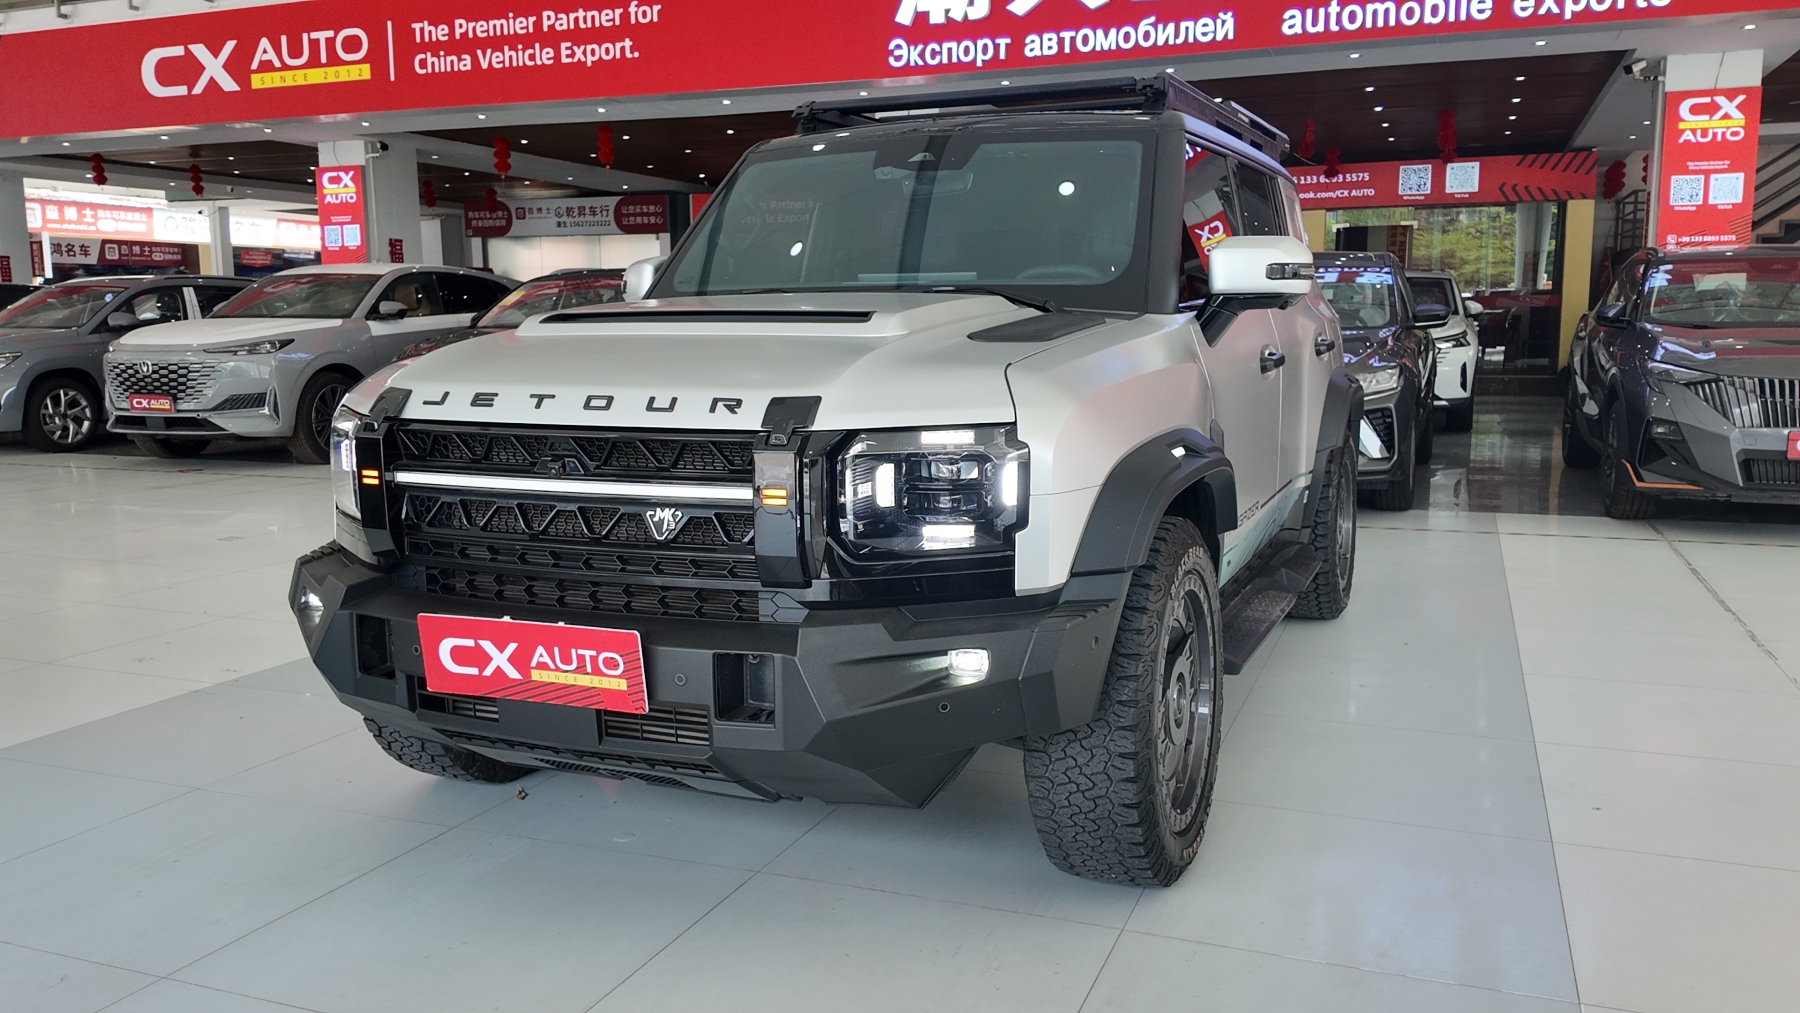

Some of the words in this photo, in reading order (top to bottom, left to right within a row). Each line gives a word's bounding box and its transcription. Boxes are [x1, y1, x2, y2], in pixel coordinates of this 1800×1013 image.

[411, 20, 449, 43] The
[454, 12, 537, 40] Premier
[542, 7, 624, 32] Partner
[628, 0, 662, 24] for
[1281, 0, 1493, 35] automobile
[250, 27, 369, 70] AUTO
[888, 37, 1011, 67] Экспорт
[1024, 11, 1235, 58] автомобилей
[141, 40, 241, 98] CX
[413, 51, 472, 75] China
[476, 42, 555, 70] Vehicle
[560, 37, 640, 67] Export.
[260, 73, 309, 85] SINCE
[323, 68, 363, 80] 2012
[1678, 94, 1747, 121] CX
[1678, 127, 1745, 144] AUTO
[322, 171, 355, 189] CX
[1299, 176, 1318, 184] 133
[1345, 172, 1370, 182] 5575
[324, 193, 357, 204] AUTO
[1351, 188, 1375, 197] AUTO
[132, 398, 150, 409] CX
[422, 390, 743, 415] JETOUR
[438, 637, 524, 680] CX
[530, 645, 625, 676] AUTO
[538, 672, 579, 683] SINCE
[589, 677, 622, 688] 2012
